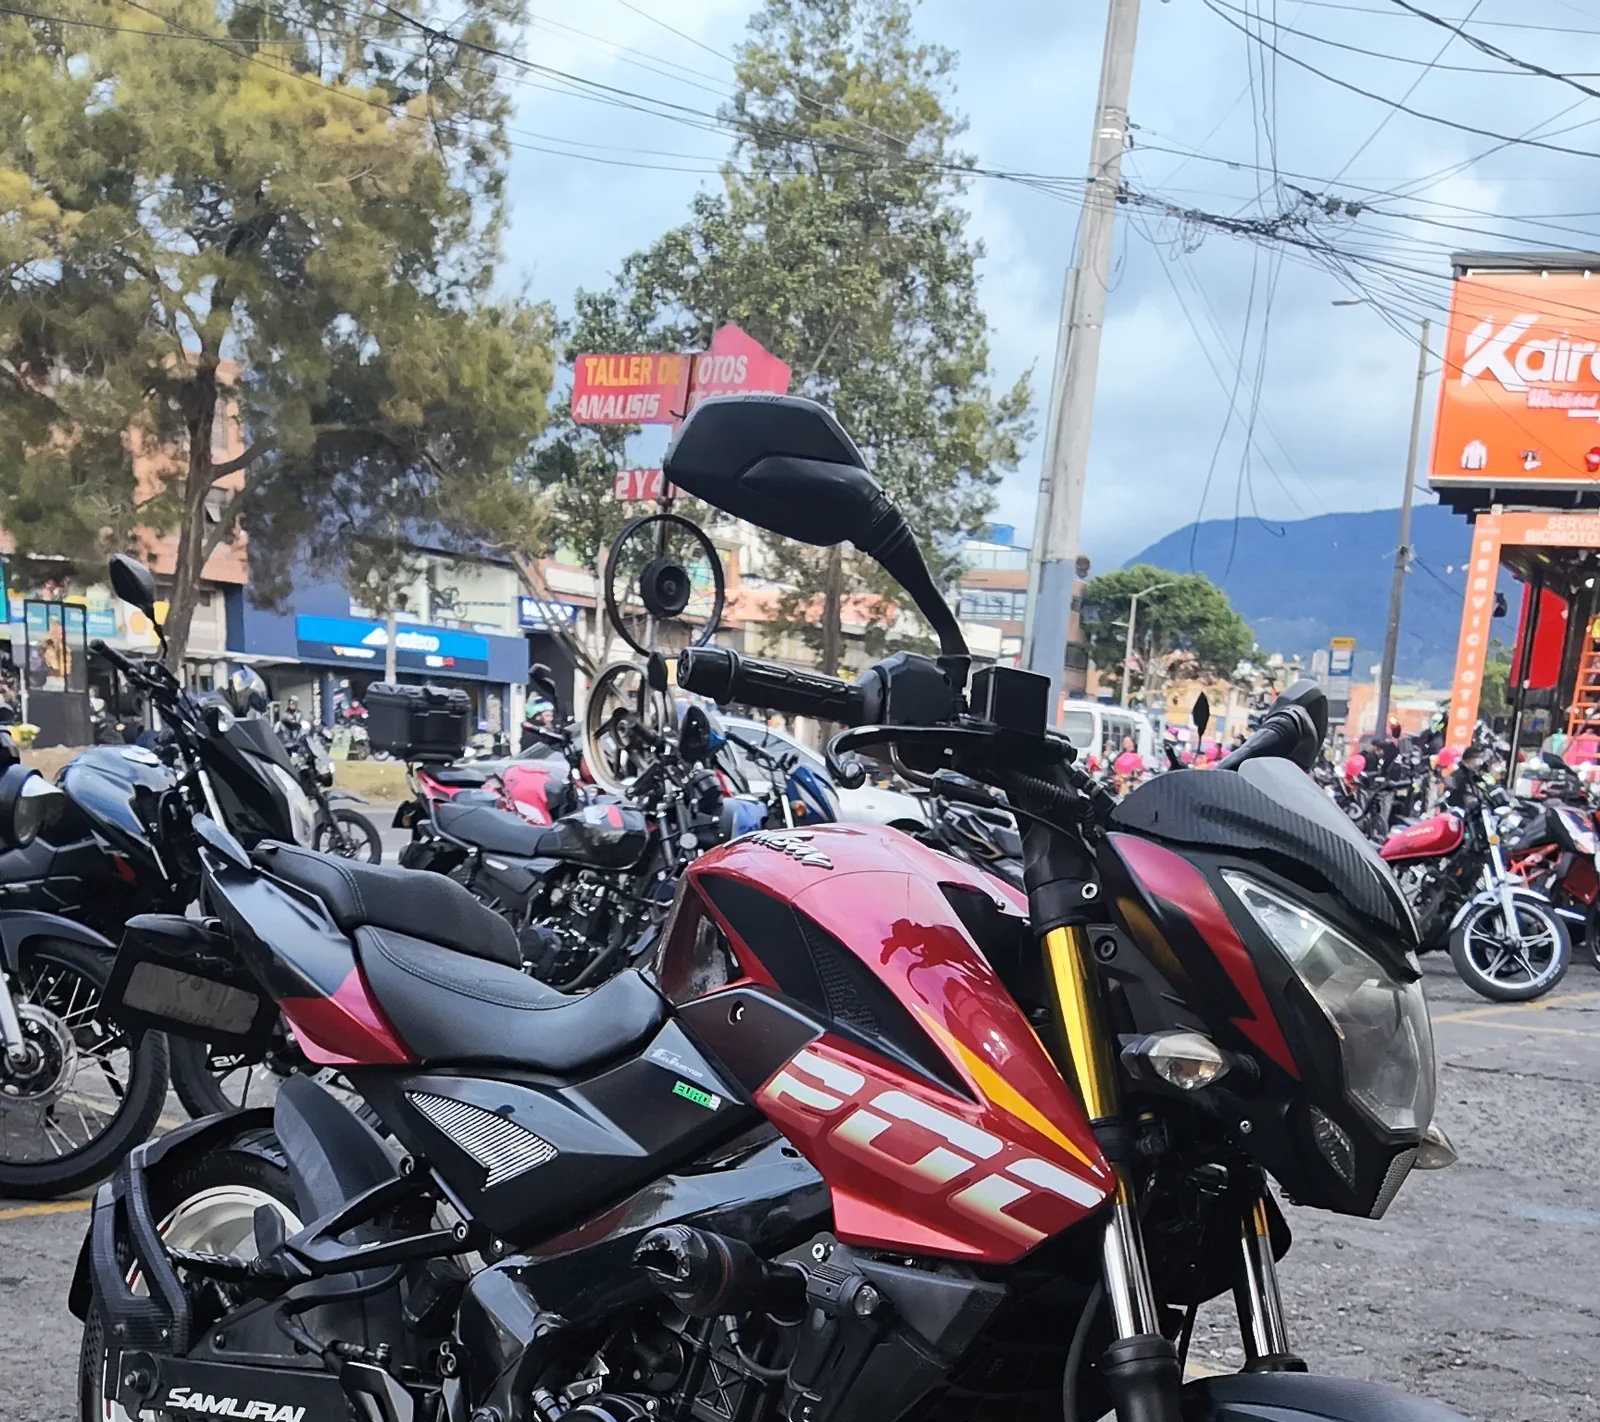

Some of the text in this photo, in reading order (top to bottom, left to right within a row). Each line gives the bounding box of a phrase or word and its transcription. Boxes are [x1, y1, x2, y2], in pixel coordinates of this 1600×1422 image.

[585, 355, 748, 387] TALLER DE OTOS
[572, 394, 661, 420] ANALISIS
